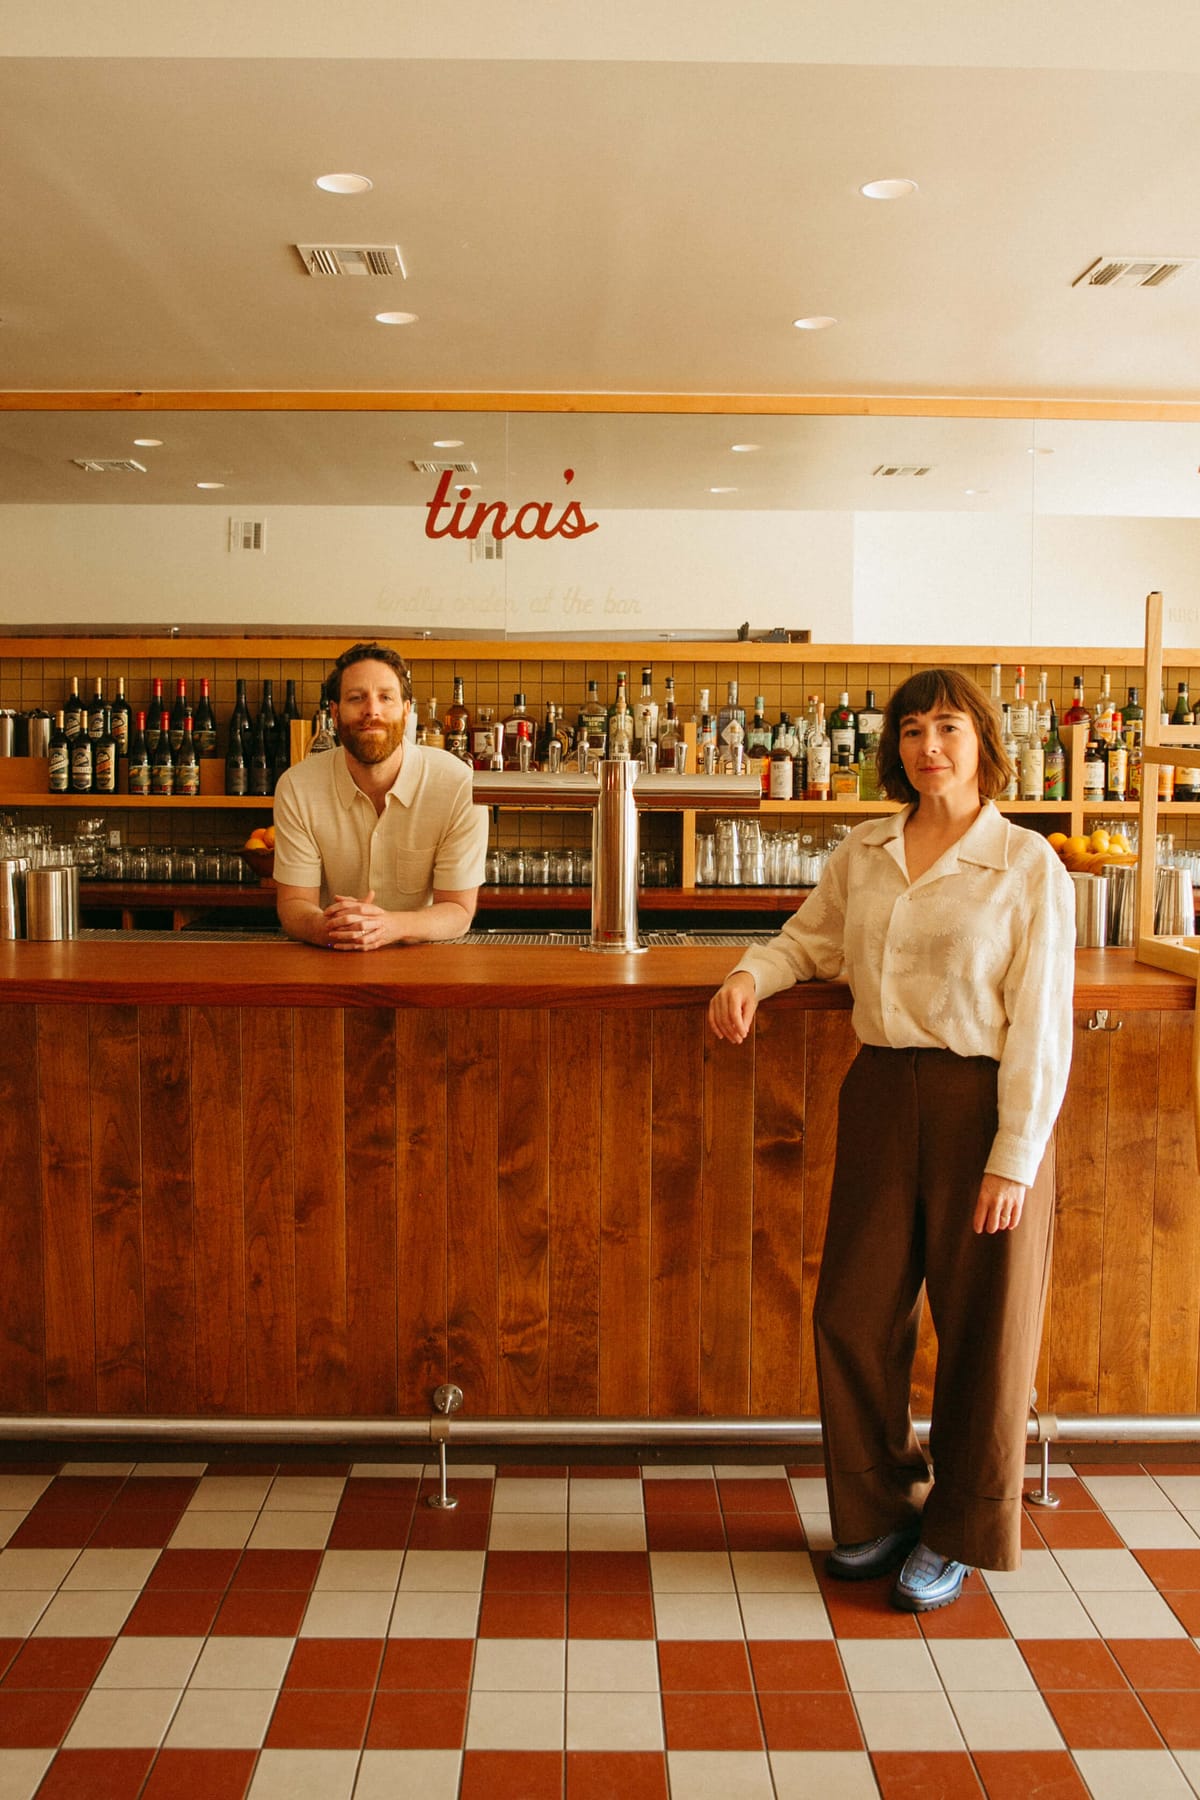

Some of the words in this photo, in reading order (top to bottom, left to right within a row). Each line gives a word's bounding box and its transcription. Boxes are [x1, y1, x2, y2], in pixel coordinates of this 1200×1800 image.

[425, 468, 599, 540] tina's
[529, 586, 556, 615] at
[563, 584, 593, 615] the
[603, 585, 642, 615] bar
